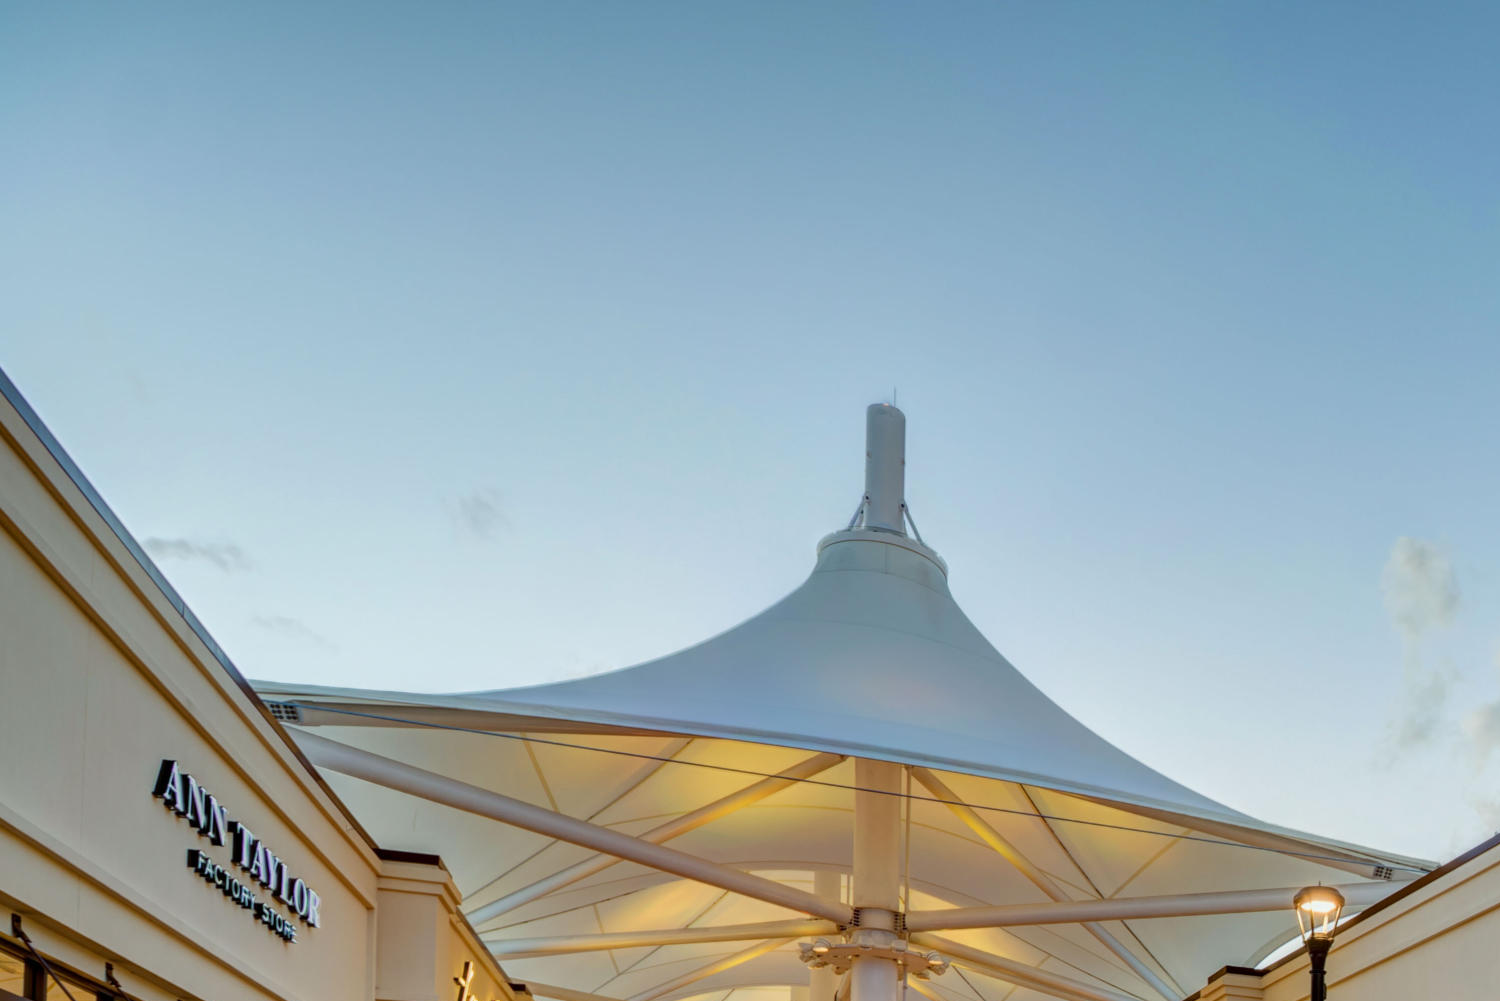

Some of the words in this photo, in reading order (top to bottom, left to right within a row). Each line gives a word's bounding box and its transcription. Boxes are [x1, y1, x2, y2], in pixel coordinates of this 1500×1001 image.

[152, 759, 228, 847] ANN
[227, 821, 321, 928] TAYLOR
[187, 849, 256, 911] FACTORY
[254, 903, 298, 944] STORE
